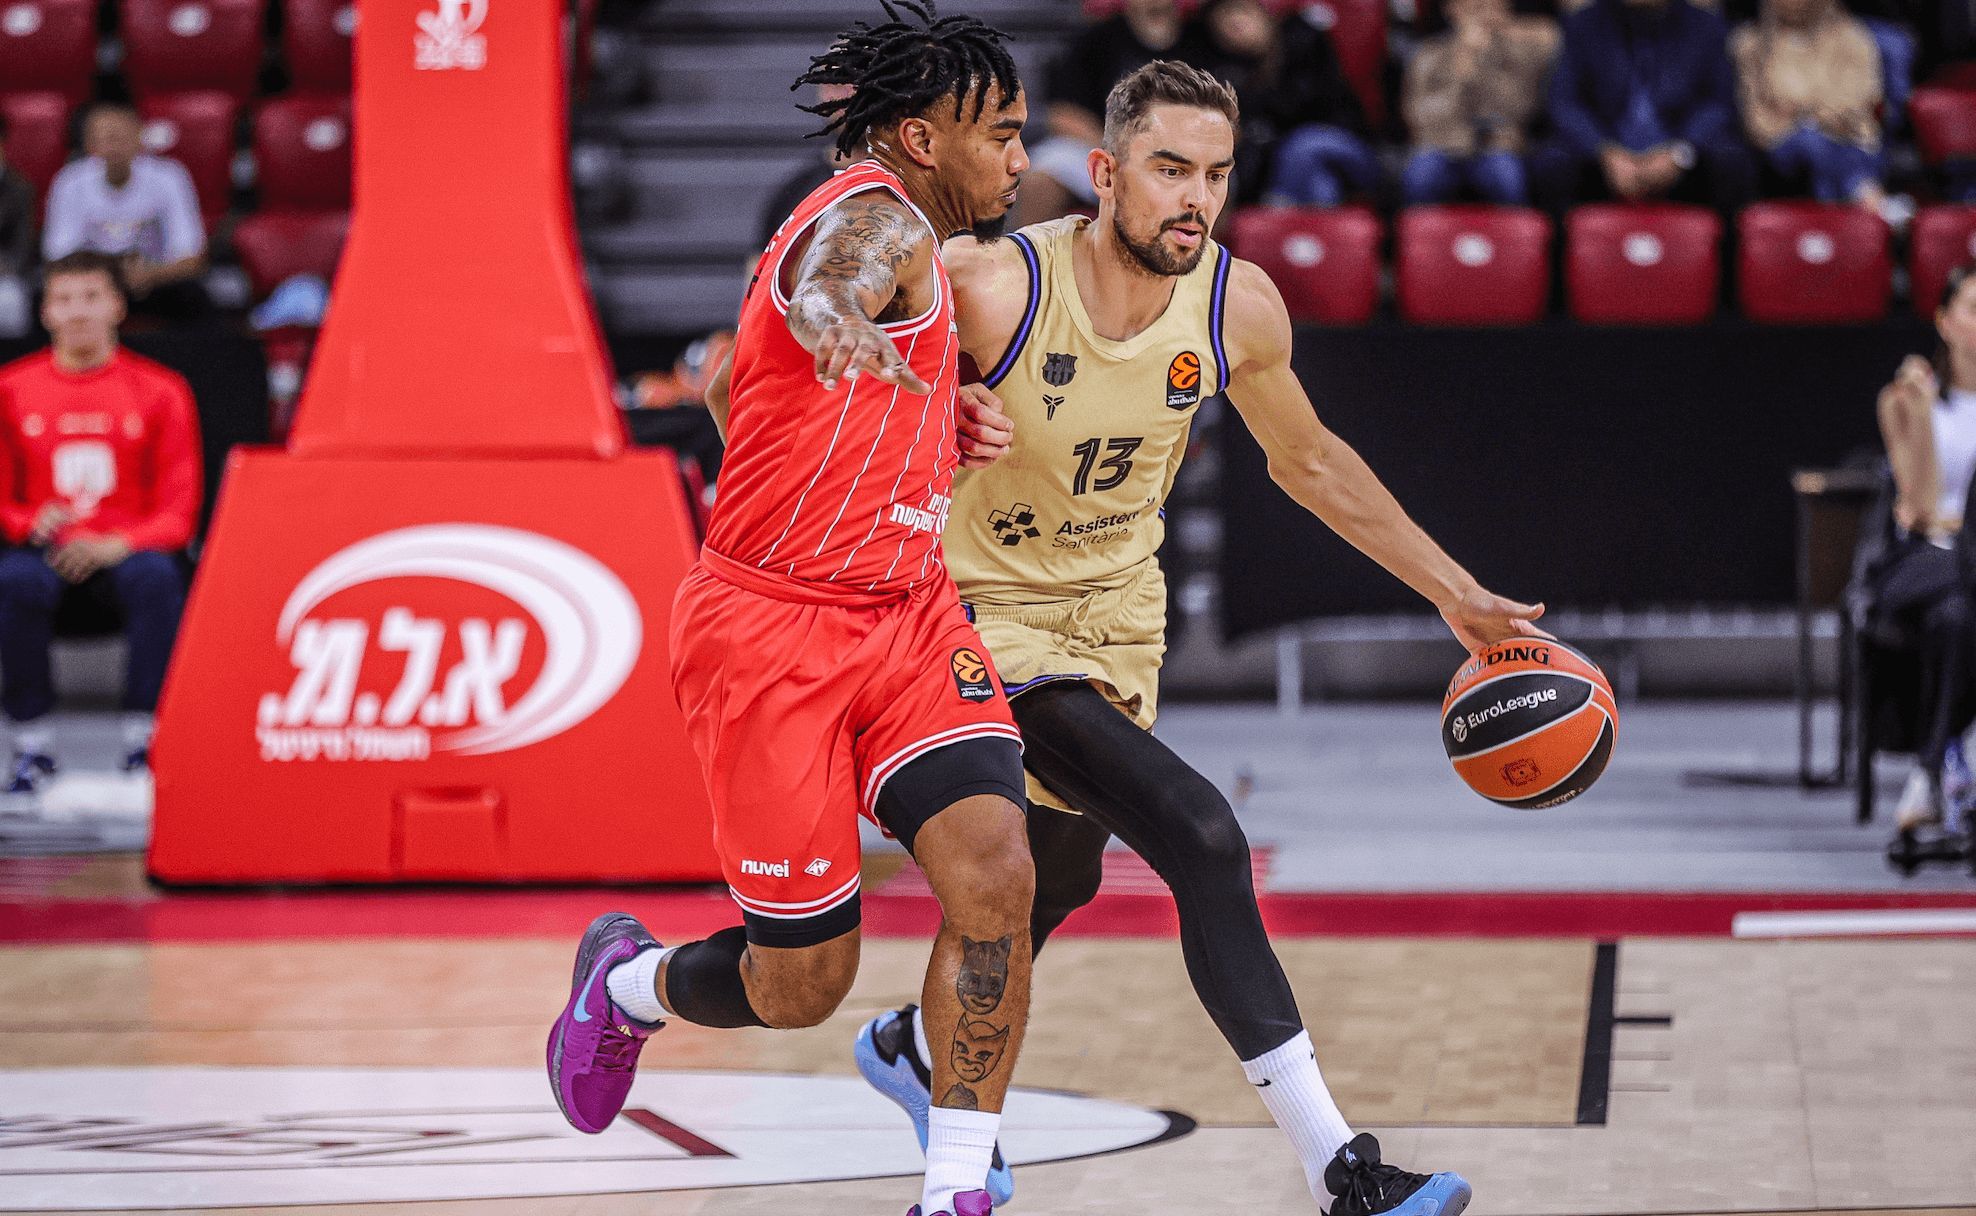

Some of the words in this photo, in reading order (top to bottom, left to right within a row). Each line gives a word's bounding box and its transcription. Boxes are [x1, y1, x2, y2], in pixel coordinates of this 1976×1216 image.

[1072, 437, 1144, 496] 13
[1467, 688, 1557, 729] EuroLeague
[741, 859, 790, 877] nuvei
